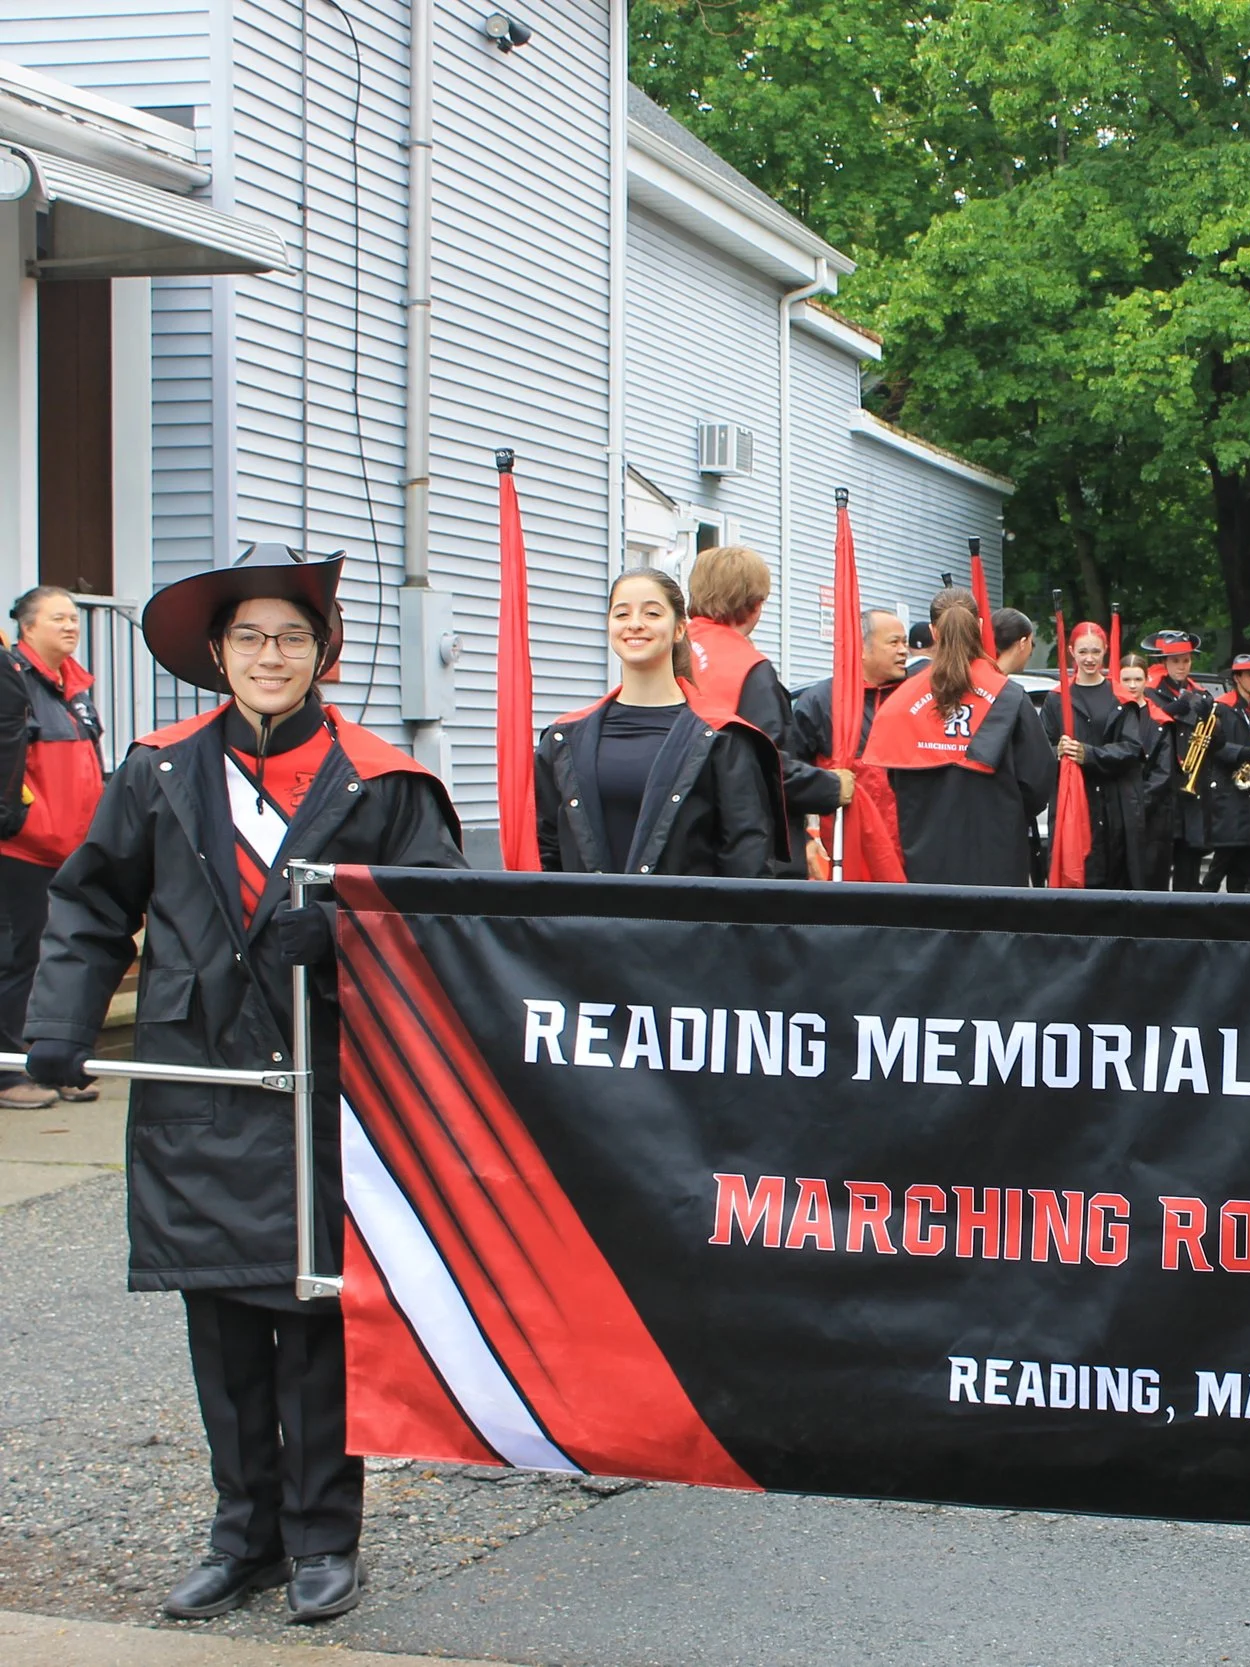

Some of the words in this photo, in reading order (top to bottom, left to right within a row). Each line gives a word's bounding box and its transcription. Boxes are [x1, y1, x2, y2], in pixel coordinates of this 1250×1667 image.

[909, 692, 933, 715] READ
[521, 998, 827, 1079] READING
[706, 1172, 1132, 1267] MARCHING
[946, 1356, 1176, 1424] READING,
